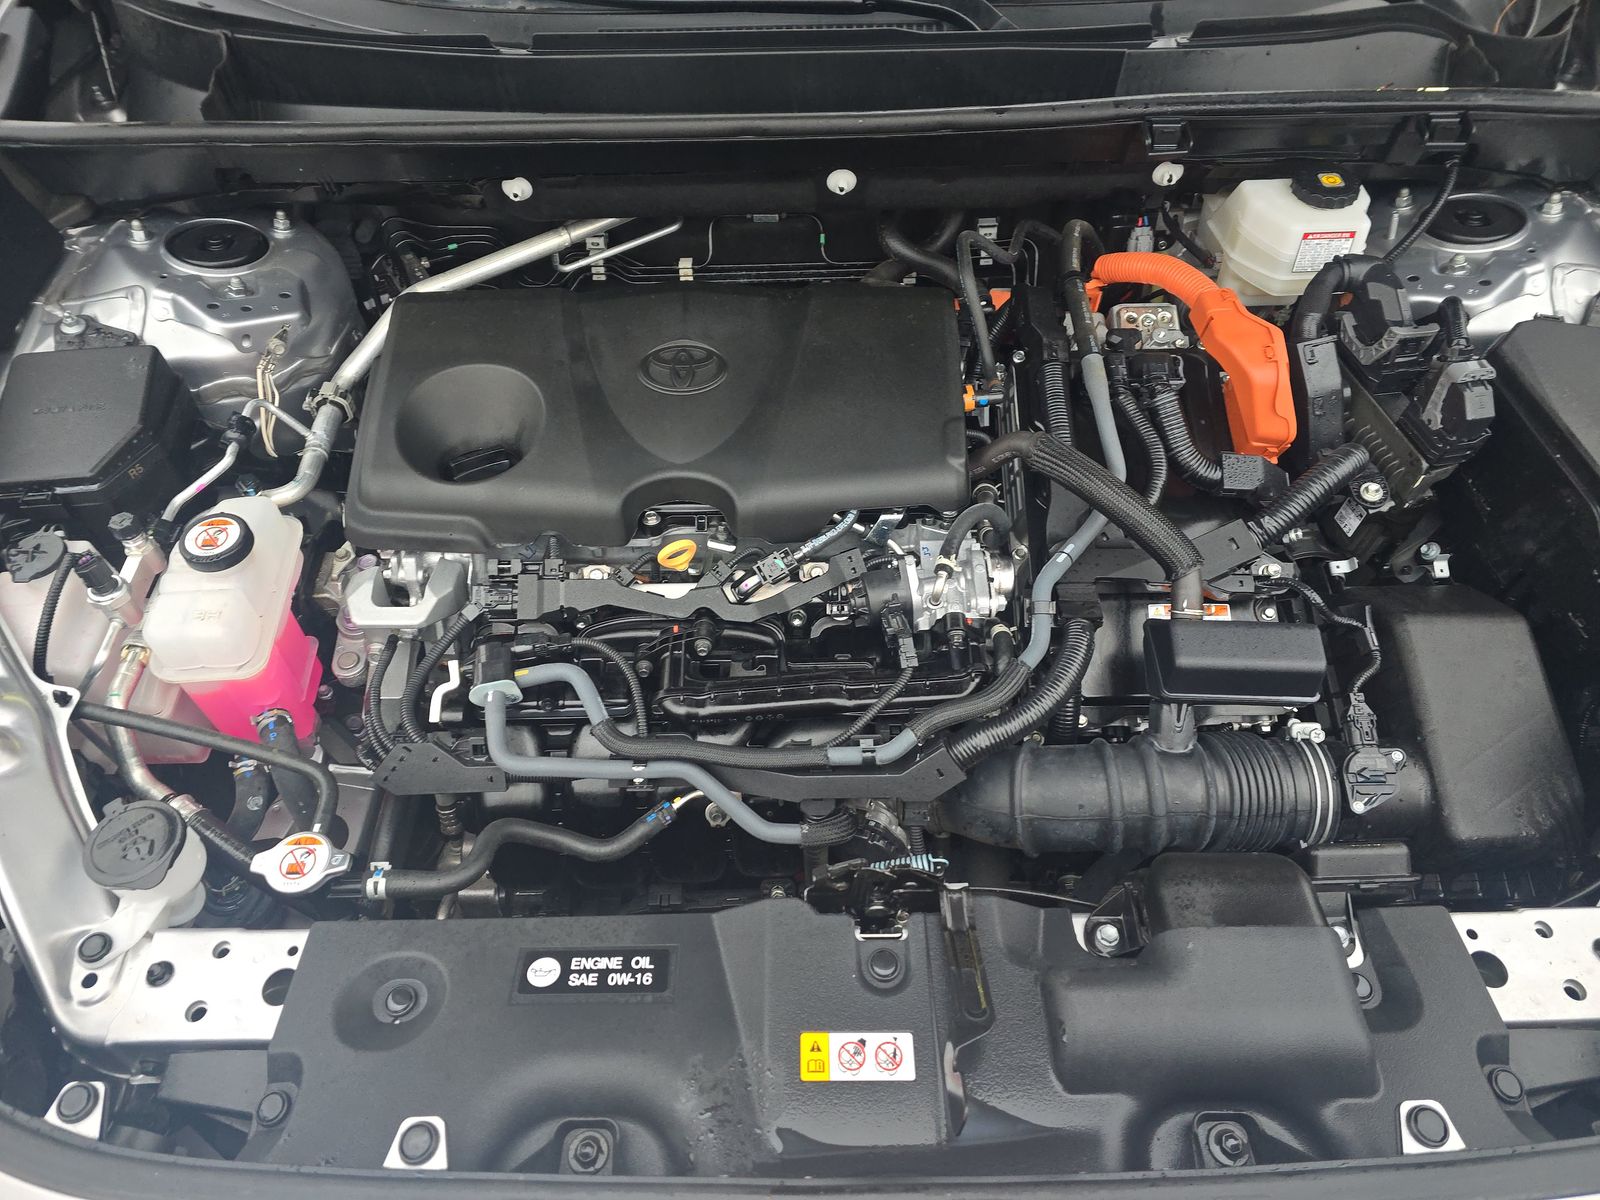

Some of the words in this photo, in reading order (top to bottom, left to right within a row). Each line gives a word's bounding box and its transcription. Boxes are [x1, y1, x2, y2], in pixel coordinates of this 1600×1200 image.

[570, 956, 624, 970] ENGINE
[630, 956, 655, 969] OIL
[567, 972, 599, 987] SAE
[607, 972, 653, 986] 0W-16
